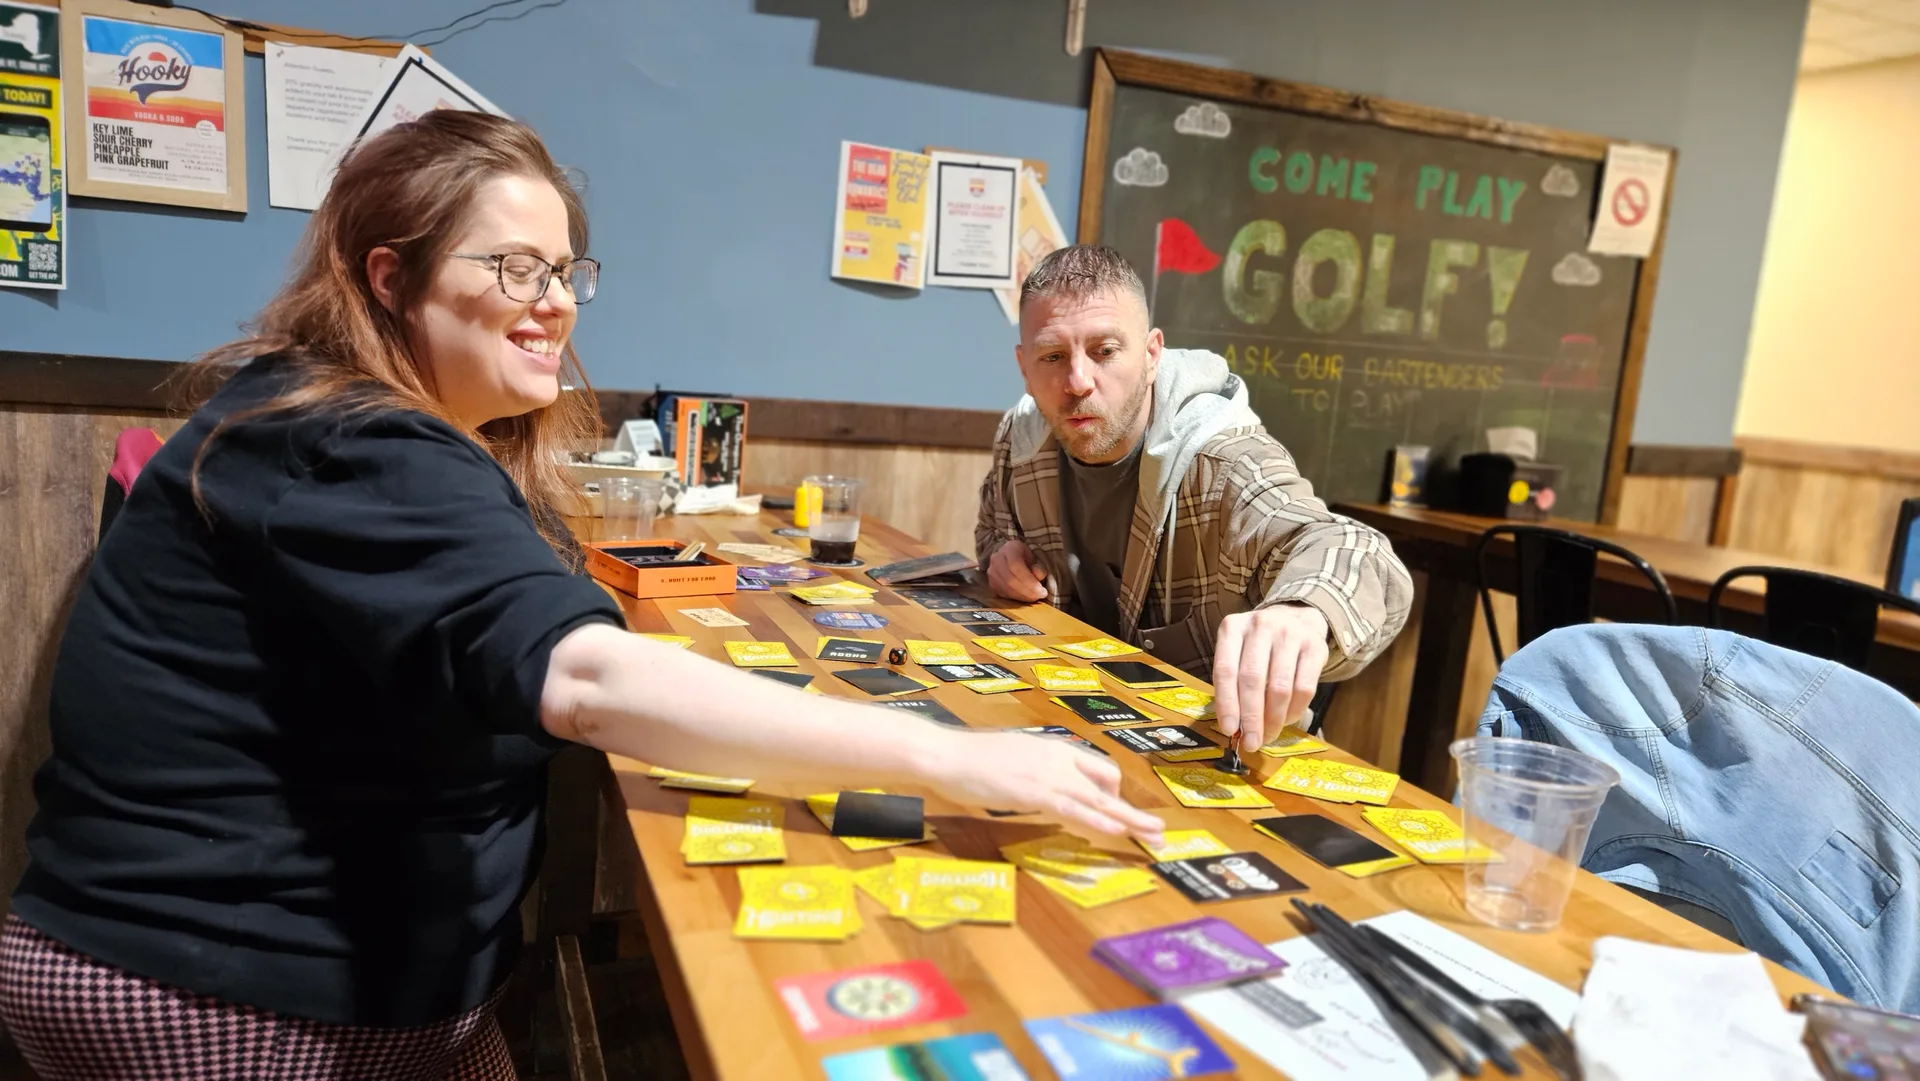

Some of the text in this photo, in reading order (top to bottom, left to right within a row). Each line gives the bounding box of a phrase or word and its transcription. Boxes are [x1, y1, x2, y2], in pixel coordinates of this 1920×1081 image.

[118, 55, 192, 90] Hooky
[2, 88, 46, 105] TODAY!
[134, 111, 158, 121] VODKA
[166, 114, 185, 124] SODA
[93, 122, 134, 137] KEY LIME
[93, 133, 153, 149] SOUR CHERRY
[93, 142, 141, 157] PINEAPPLE
[93, 152, 114, 165] PINK
[117, 155, 169, 170] GRAPEFRUIT
[1249, 147, 1527, 225] COME PLAY
[1222, 219, 1531, 350] GOLF!
[1224, 343, 1504, 390] ASK OUR BARTENDERS
[1292, 387, 1330, 413] TO
[1096, 713, 1136, 721] TREES
